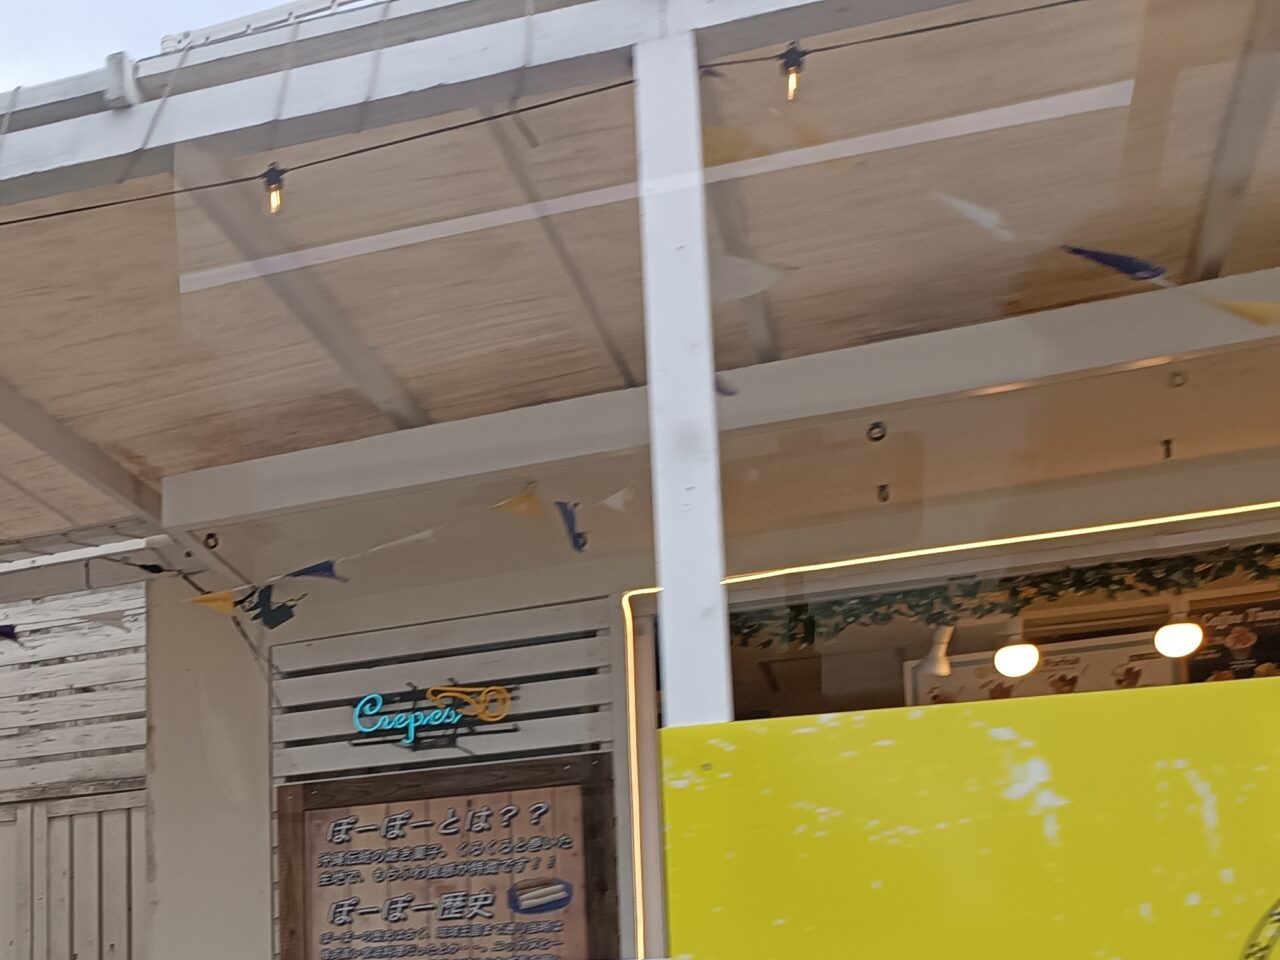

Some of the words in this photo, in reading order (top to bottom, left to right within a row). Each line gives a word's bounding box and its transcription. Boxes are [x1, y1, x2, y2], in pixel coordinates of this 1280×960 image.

[353, 693, 463, 746] Crepes
[328, 890, 496, 926] ぽーぽー歴史
